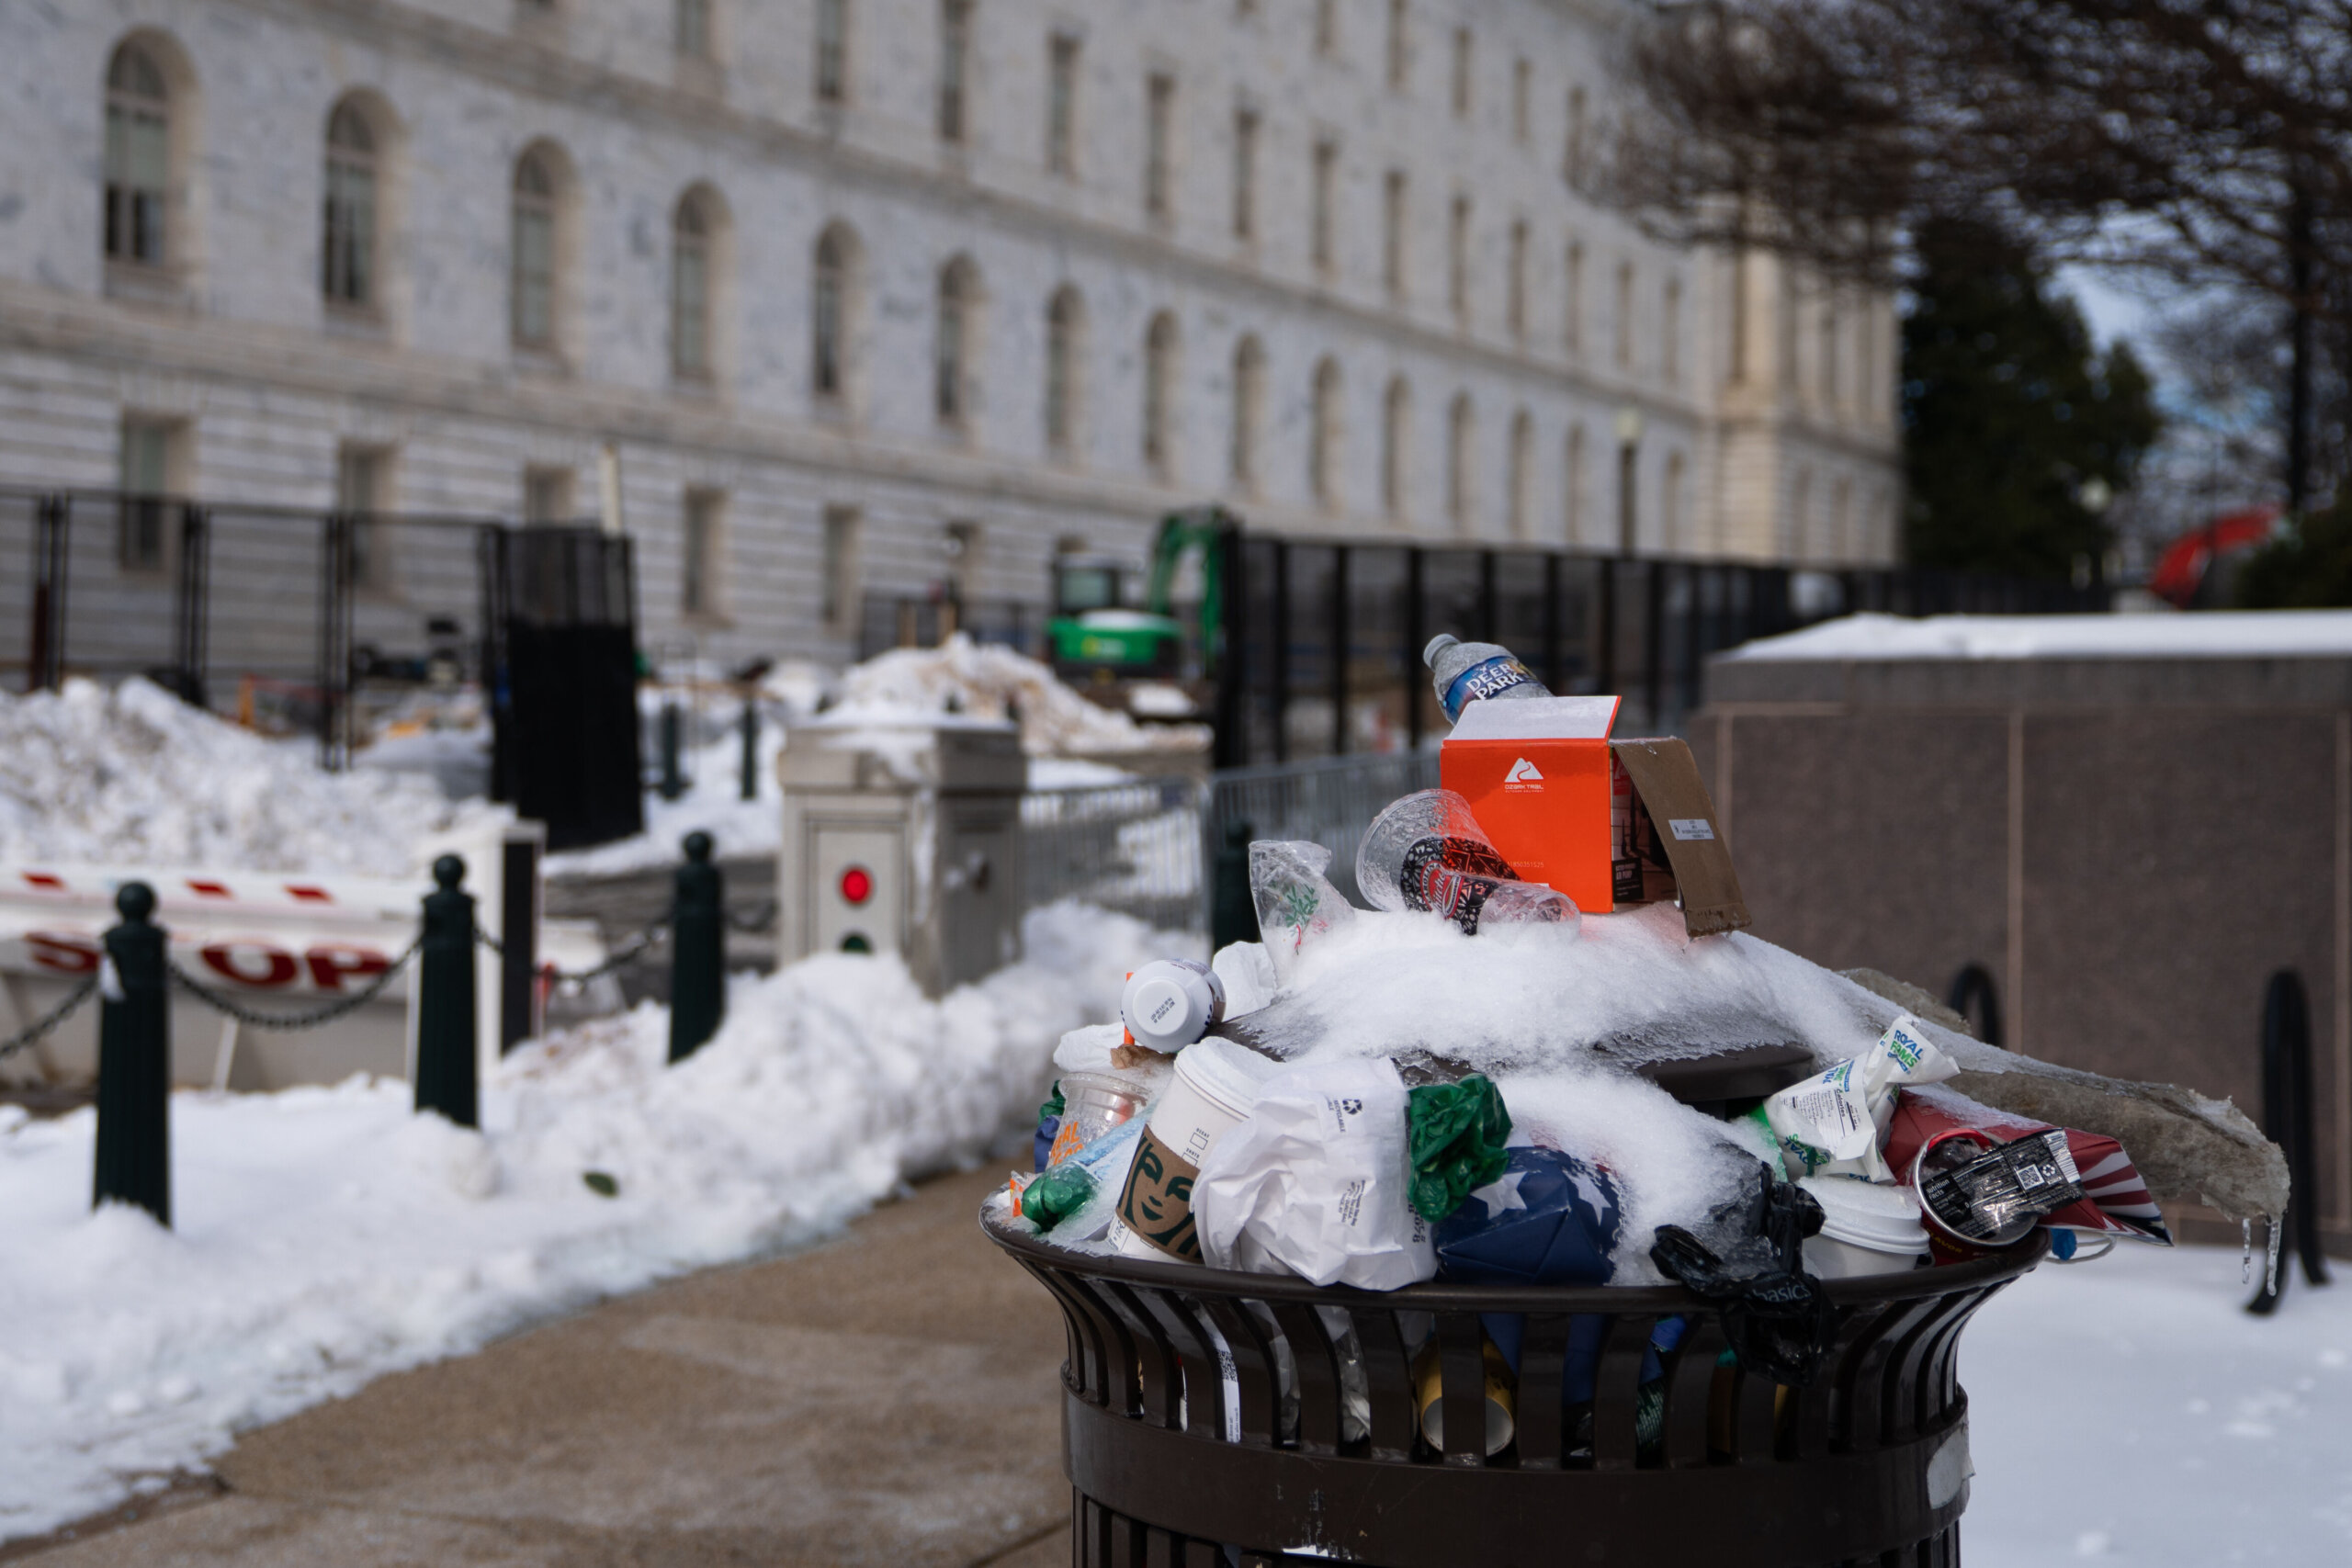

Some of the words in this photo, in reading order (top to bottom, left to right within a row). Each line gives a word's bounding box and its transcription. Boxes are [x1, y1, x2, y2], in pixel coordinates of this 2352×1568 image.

[1465, 663, 1515, 693] DEER
[1475, 672, 1523, 700] PARK
[24, 931, 393, 990] SOP
[1894, 1030, 1923, 1060] ROYAL
[1837, 1089, 1846, 1118] Calories
[1926, 1179, 1950, 1194] Nutrition
[1928, 1189, 1945, 1201] Facts
